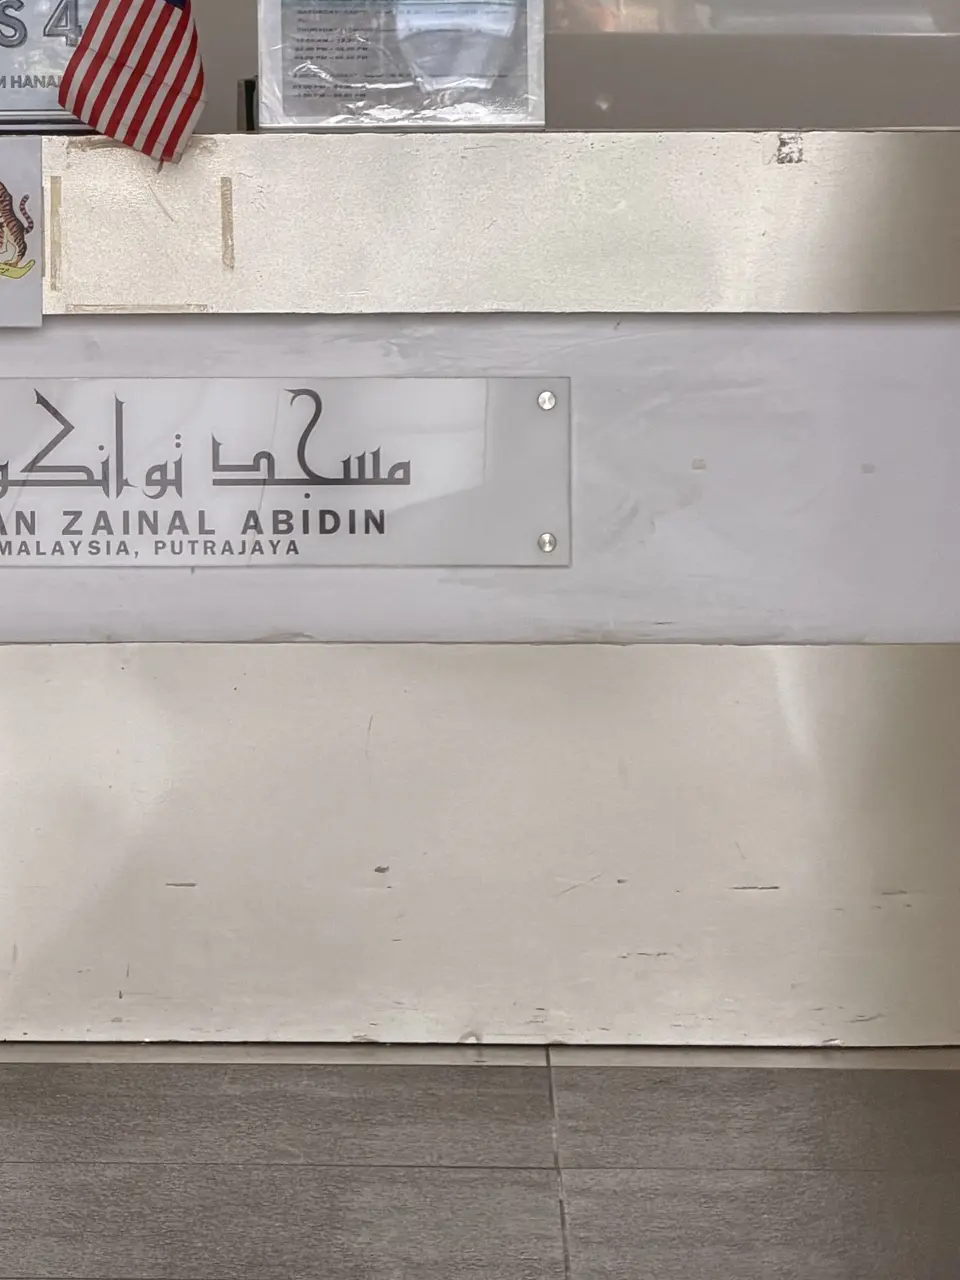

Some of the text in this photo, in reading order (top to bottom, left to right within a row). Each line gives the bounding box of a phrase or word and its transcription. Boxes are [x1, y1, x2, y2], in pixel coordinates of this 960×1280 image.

[11, 75, 62, 89] HANA
[61, 510, 216, 535] ZAINAL
[241, 509, 385, 535] ABIDIN
[154, 540, 300, 556] PUTRAJAYA
